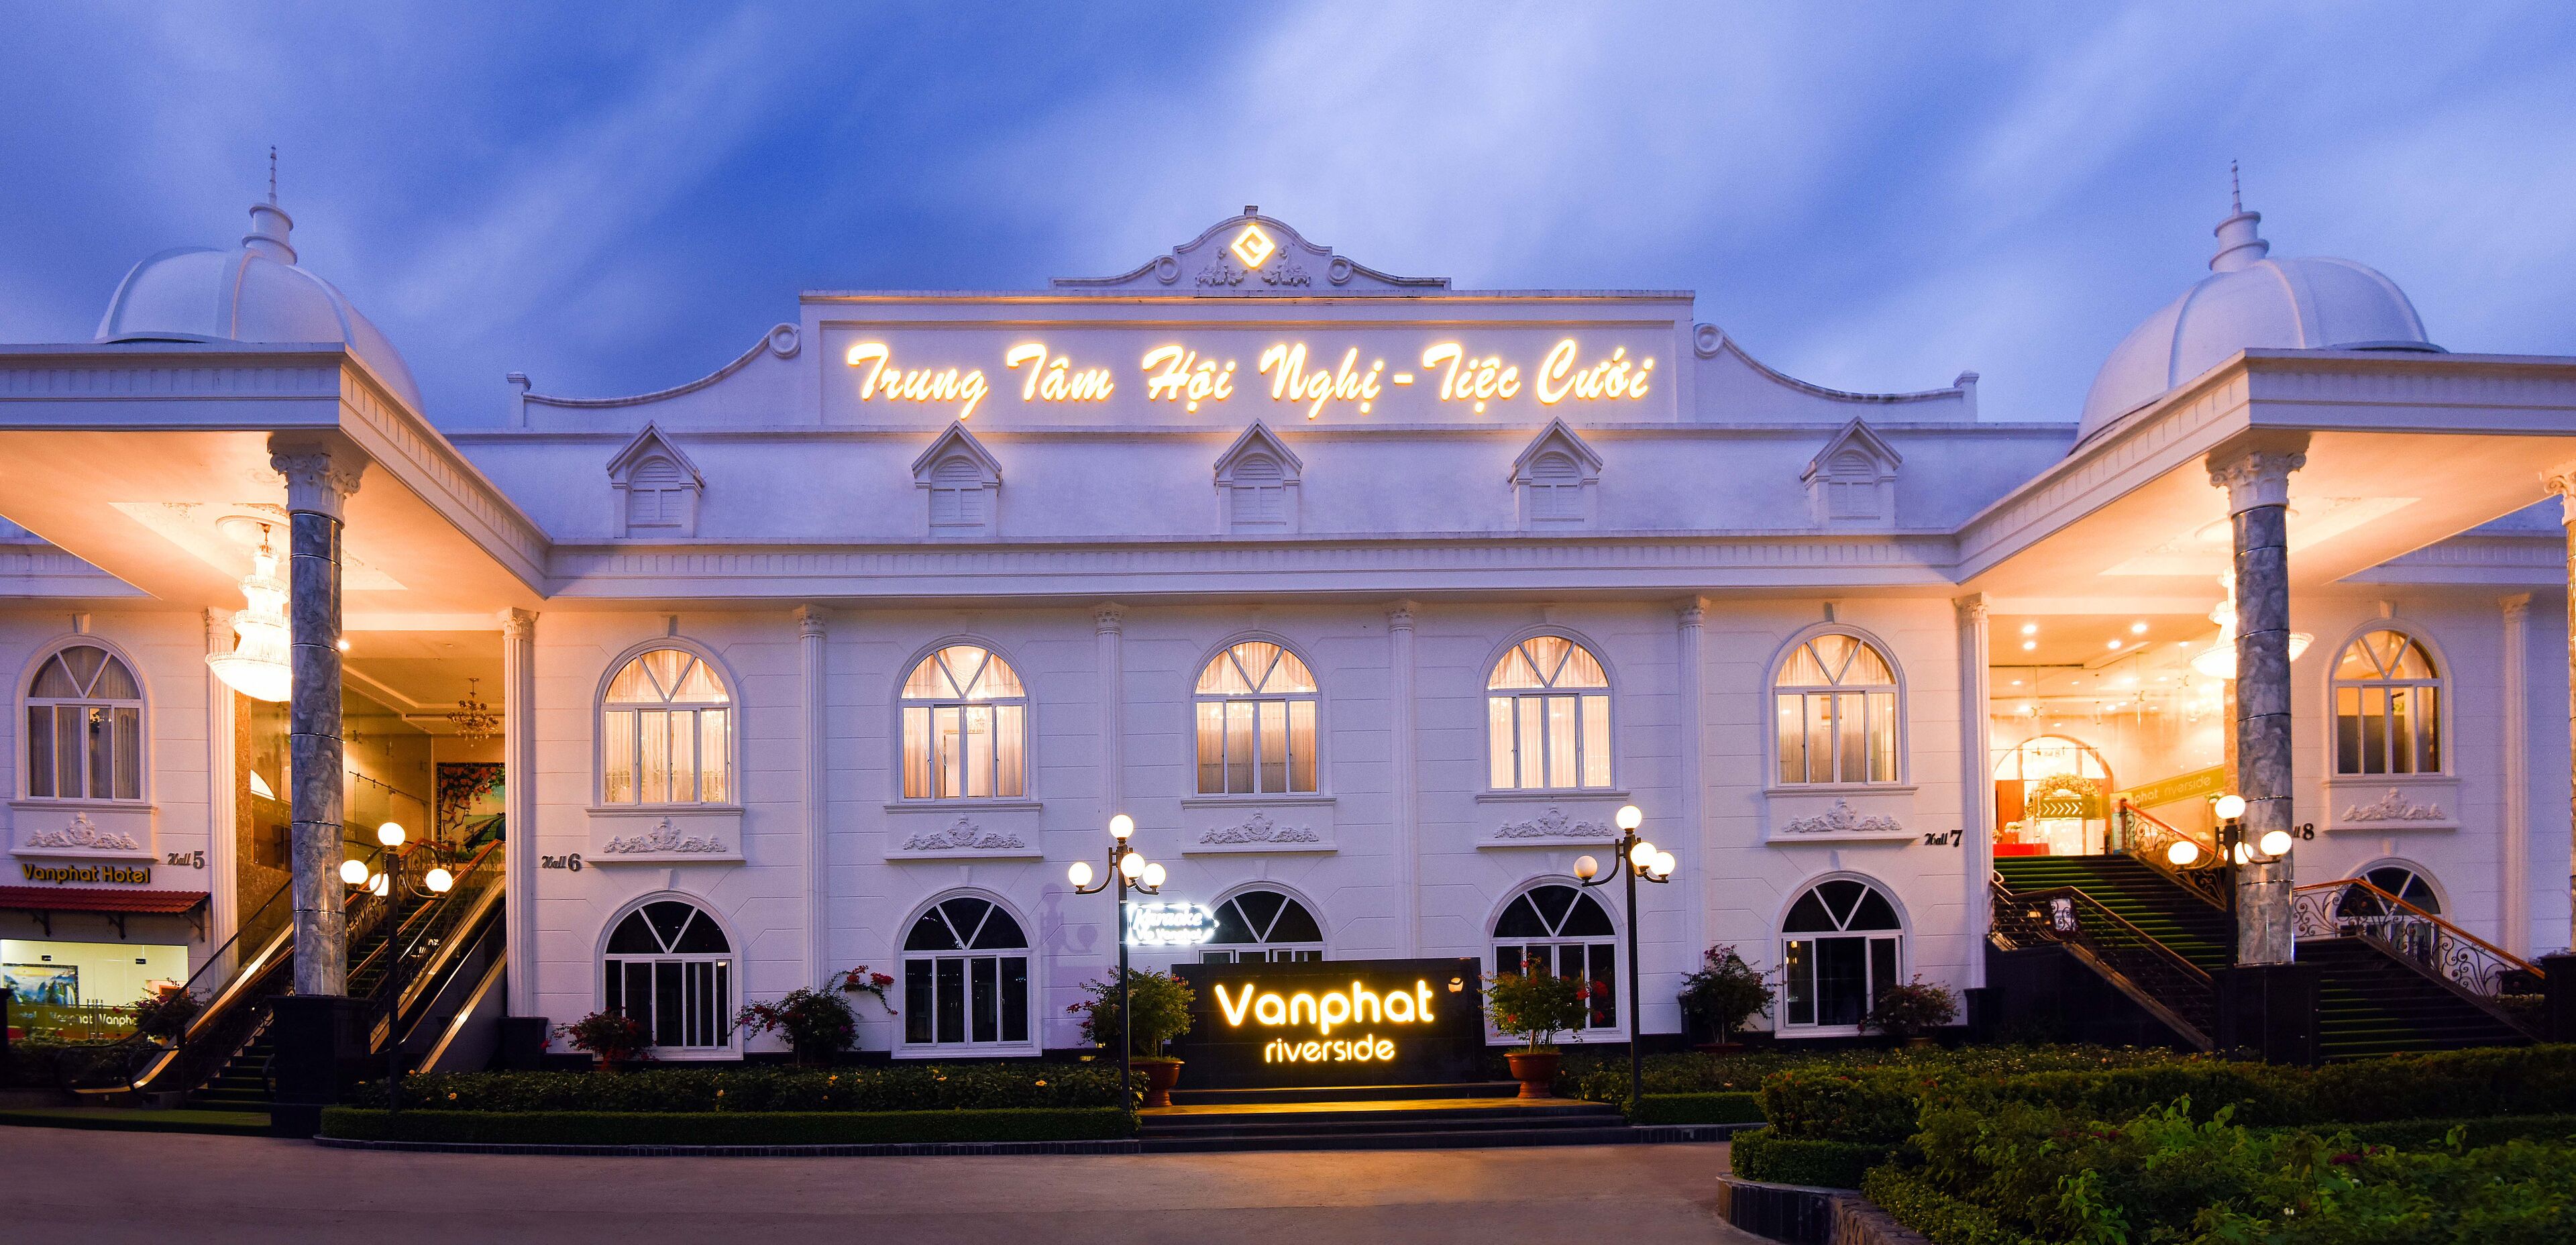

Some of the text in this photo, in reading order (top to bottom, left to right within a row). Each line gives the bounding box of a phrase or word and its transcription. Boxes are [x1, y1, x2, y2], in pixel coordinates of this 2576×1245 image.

[847, 341, 989, 420] Trung
[1006, 341, 1115, 401] Tâm
[1142, 343, 1236, 413] Hội
[1259, 343, 1385, 419] Nghị
[1421, 341, 1521, 414] Tiệc
[1536, 338, 1654, 404] Cưới
[2164, 775, 2212, 797] riverside
[1924, 829, 1963, 847] Hall 7
[2303, 823, 2314, 841] 8
[168, 851, 205, 869] Hall 5
[541, 853, 582, 872] Hall 6
[21, 863, 152, 885] Vanphat Hotel
[1132, 908, 1203, 930] Karaoke
[1215, 979, 1434, 1036] Vanphat
[1265, 1033, 1395, 1063] riverside
